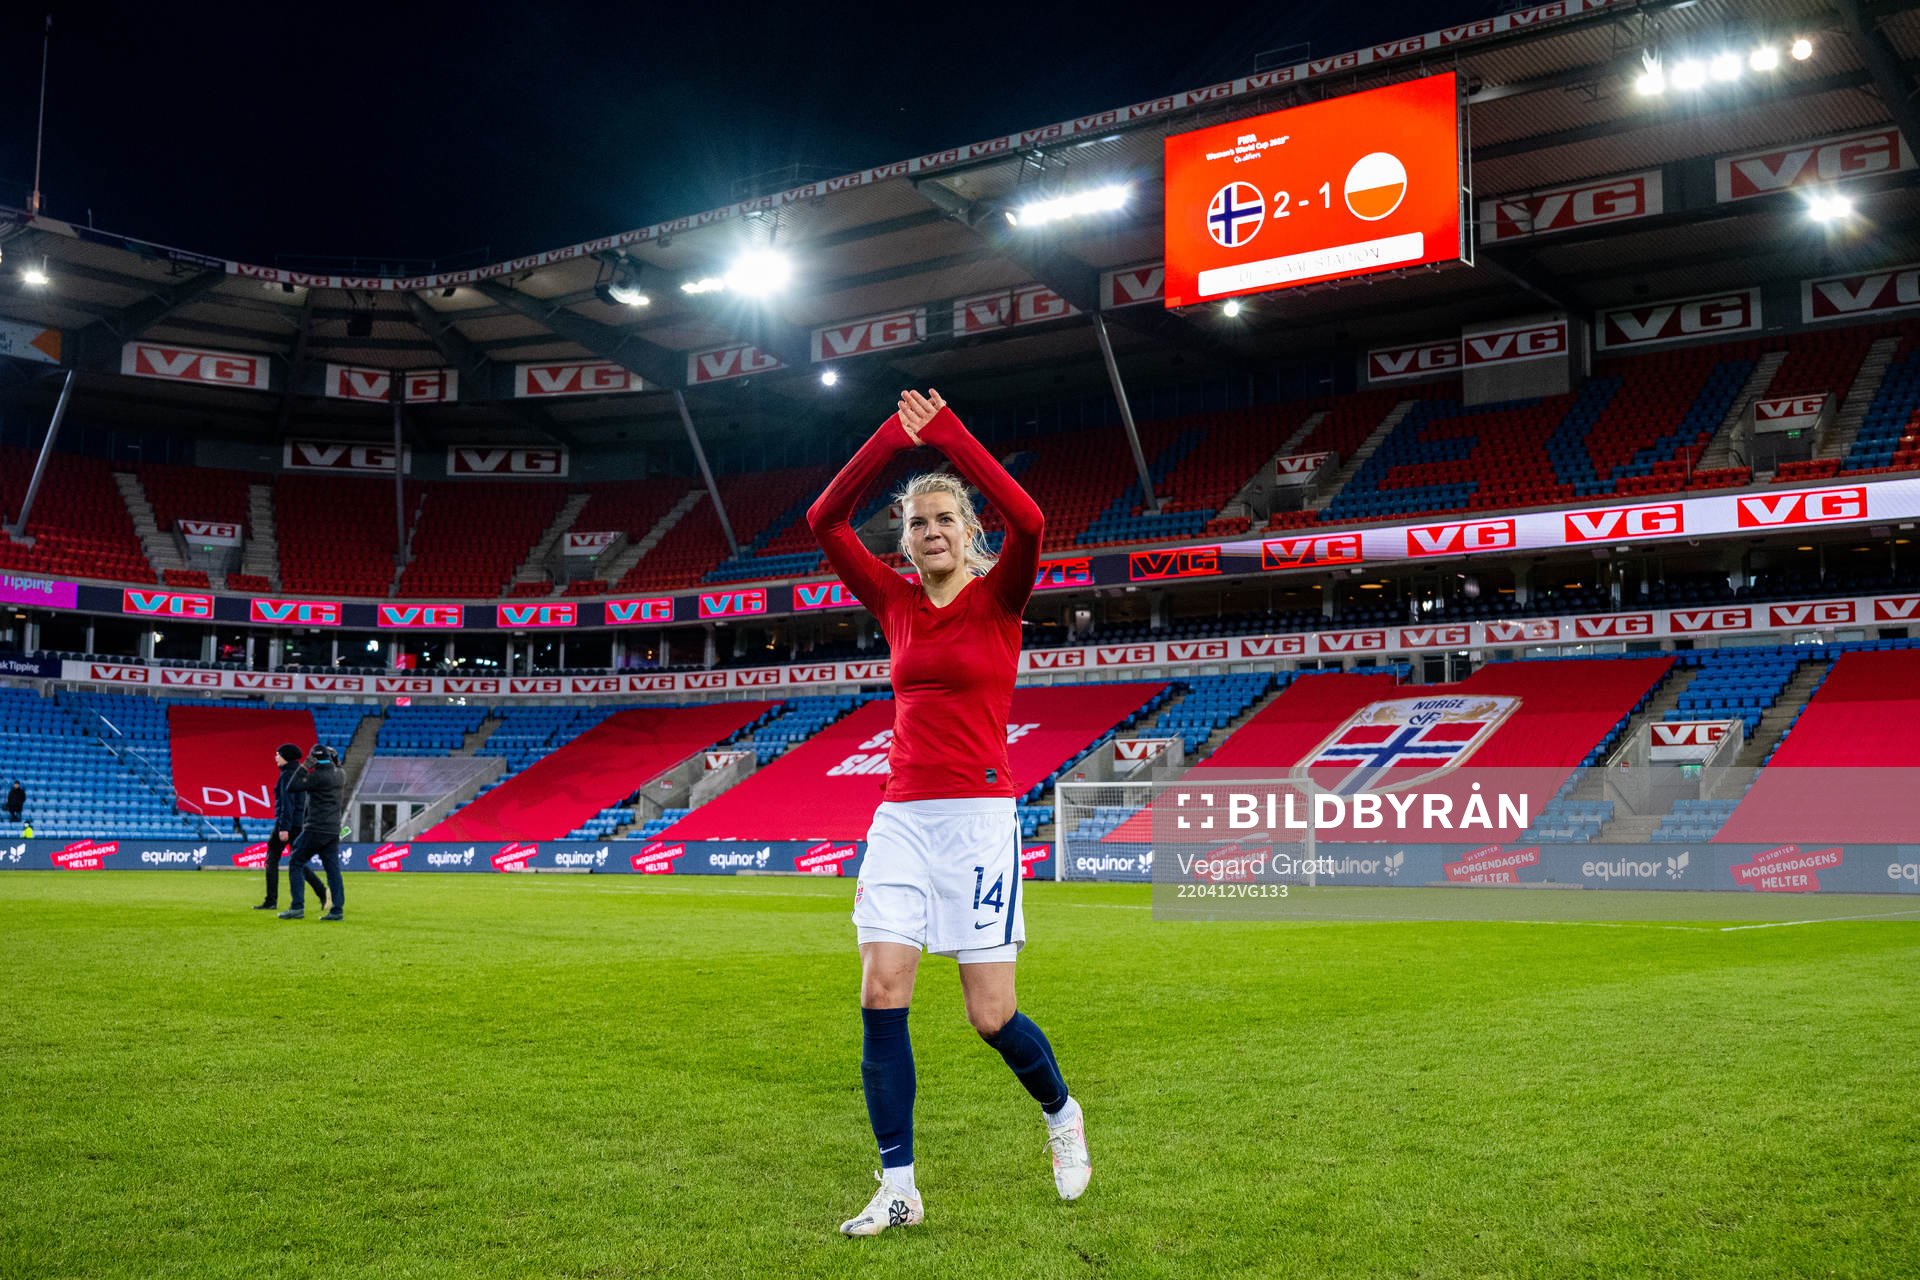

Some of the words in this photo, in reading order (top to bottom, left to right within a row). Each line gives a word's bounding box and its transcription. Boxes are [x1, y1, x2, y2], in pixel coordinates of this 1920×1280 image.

[826, 176, 860, 190] VG
[874, 162, 908, 178] VG
[921, 151, 958, 166] VG
[971, 138, 1008, 154] VG
[1021, 125, 1060, 140] VG
[1077, 112, 1115, 128] VG
[1130, 98, 1172, 115] VG
[1188, 83, 1231, 102] VG
[1250, 69, 1293, 87] VG
[1311, 55, 1356, 74] VG
[1374, 38, 1424, 59] VG
[1442, 21, 1491, 42] VG
[1512, 4, 1563, 25] VG
[1733, 134, 1890, 191] VG
[1273, 191, 1290, 219] 2
[1319, 182, 1330, 209] 1
[1502, 183, 1636, 232] VG
[1118, 267, 1164, 300] V
[966, 287, 1064, 331] VG
[1611, 298, 1745, 342] VG
[824, 316, 911, 358] VG
[1469, 329, 1558, 360] VG
[140, 349, 252, 386] VG
[1374, 344, 1458, 375] VG
[530, 366, 626, 393] VG
[1759, 401, 1822, 419] VG
[298, 443, 396, 469] VG
[460, 448, 556, 473] VG
[184, 522, 233, 538] VG
[127, 592, 210, 615] VG
[255, 602, 338, 623] VG
[382, 607, 460, 625] VG
[502, 607, 572, 624] VG
[610, 602, 670, 621] VG
[702, 592, 763, 613] VG
[1132, 547, 1220, 580] VG
[1266, 535, 1361, 567] VG
[1410, 524, 1511, 556] VG
[1569, 506, 1678, 540] VG
[1742, 489, 1860, 524] VG
[94, 666, 146, 681] VG
[165, 671, 220, 686] VG
[237, 674, 291, 688] VG
[307, 678, 361, 691] VG
[379, 680, 430, 692] VG
[445, 680, 498, 693] VG
[512, 680, 560, 693] VG
[574, 679, 618, 691] VG
[631, 676, 673, 690] VG
[686, 674, 725, 688] VG
[738, 670, 778, 684] VG
[791, 667, 834, 682] VG
[848, 664, 890, 678] VG
[1031, 651, 1083, 667] VG
[1099, 647, 1154, 663] VG
[1169, 643, 1226, 659] VG
[1244, 638, 1302, 655] VG
[1321, 632, 1384, 651] VG
[1402, 628, 1469, 646] VG
[1487, 621, 1558, 641] VG
[1579, 617, 1650, 636] VG
[1672, 610, 1751, 631] VG
[1772, 604, 1854, 625] VG
[1878, 599, 1920, 618] V
[8, 660, 40, 674] Tipping
[1412, 698, 1468, 711] NORGE
[1653, 725, 1731, 745] VG
[202, 785, 271, 814] DN
[58, 845, 116, 862] MORGENDAGENS
[141, 849, 190, 865] equinor
[427, 851, 463, 867] equinor
[555, 850, 596, 867] equinor
[635, 846, 683, 866] MORGENDAGENS
[709, 851, 755, 869] equinor
[800, 847, 854, 868] MORGENDAGENS
[1077, 854, 1135, 874] equinor
[1453, 852, 1535, 877] MORGENDAGENS
[1741, 852, 1838, 879] MORGENDAGENS
[1758, 855, 1767, 863] VI
[1766, 846, 1795, 861] STØTTER
[1470, 872, 1510, 884] HELTER
[1582, 857, 1662, 882] equinor
[1761, 875, 1808, 889] HELTER
[973, 866, 1005, 913] 14
